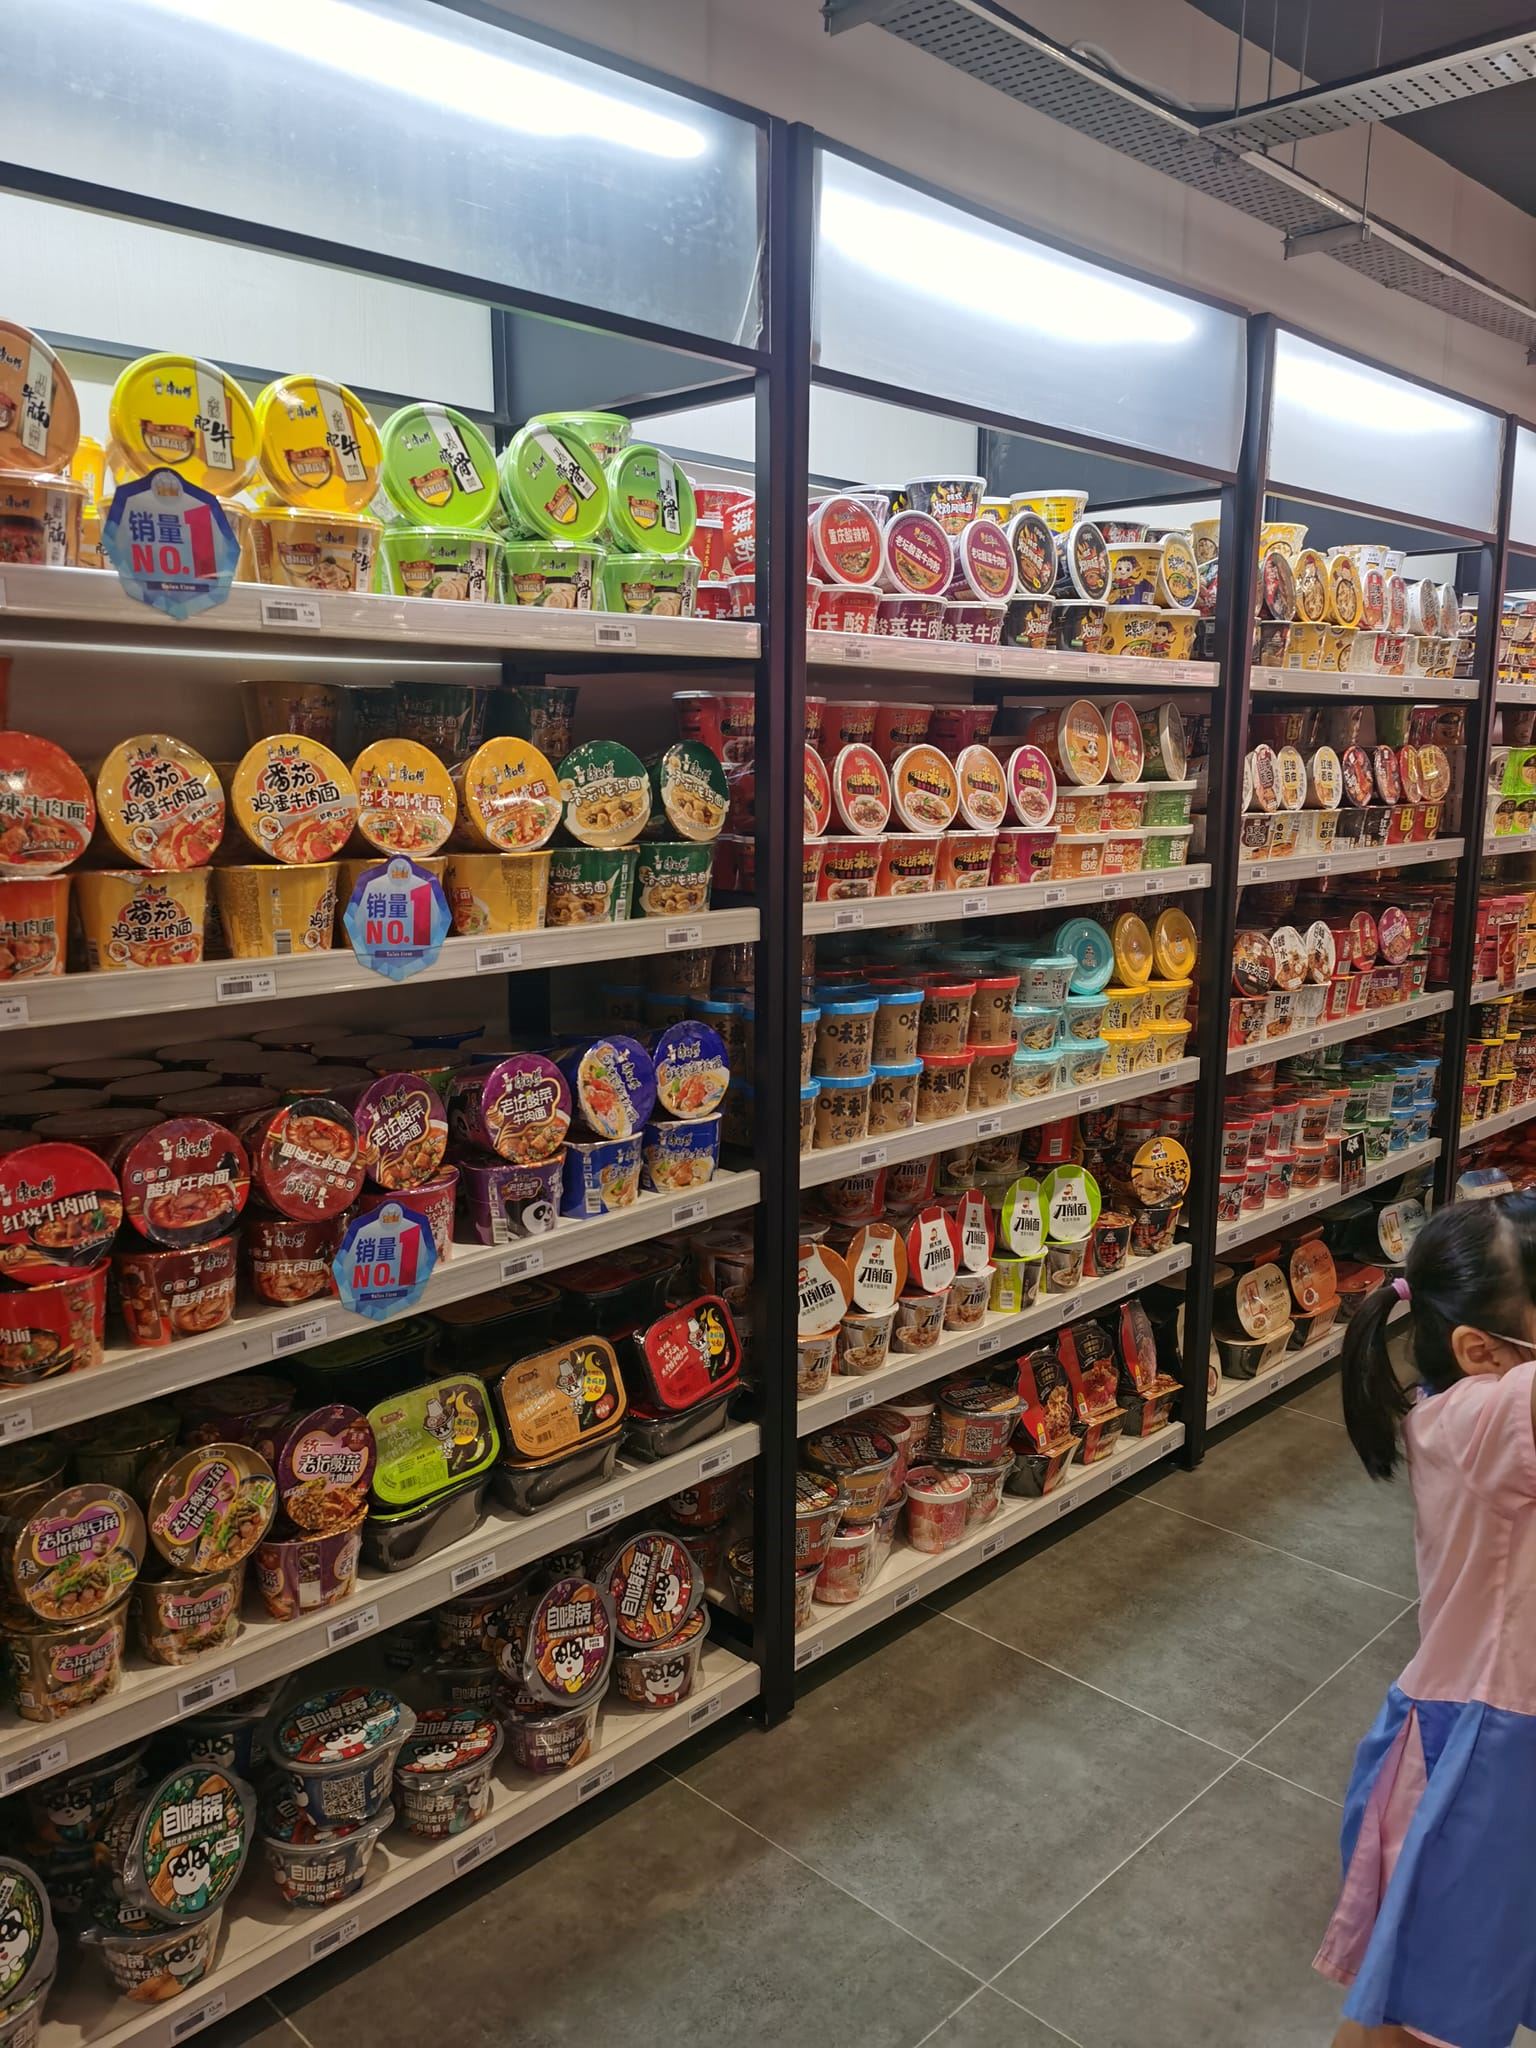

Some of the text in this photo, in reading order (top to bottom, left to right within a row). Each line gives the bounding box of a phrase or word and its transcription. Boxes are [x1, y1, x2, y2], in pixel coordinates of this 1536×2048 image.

[128, 510, 185, 546] 销量
[828, 526, 871, 546] 重庆酸辣粉
[129, 765, 180, 799] 番茄
[264, 763, 316, 792] 番茄
[570, 775, 642, 804] 香菇炖鸡面
[120, 780, 208, 825] 鸡蛋牛肉面
[251, 779, 342, 815] 鸡蛋牛肉面
[126, 900, 178, 925] 番茄
[365, 892, 410, 920] 销量
[112, 917, 192, 943] 鸡蛋牛肉面
[499, 1087, 554, 1118] 老坛酸菜
[512, 1105, 547, 1125] 牛肉面
[371, 1100, 426, 1147] 老坛酸菜
[388, 1123, 423, 1152] 牛肉面
[16, 1174, 57, 1202] 康师傅
[146, 1167, 231, 1200] 酸辣牛肉面
[0, 1191, 101, 1236] 红烧牛肉面
[1013, 1216, 1040, 1232] 刀削面
[1053, 1202, 1088, 1220] 刀削面
[355, 1237, 397, 1264] 销量
[965, 1229, 986, 1246] 刀削面
[923, 1244, 952, 1270] 刀削面
[857, 1266, 893, 1285] 刀削面
[298, 1453, 362, 1475] 老坛酸菜
[170, 1459, 229, 1537] 老坛酸豆角
[38, 1512, 121, 1549] 老坛酸豆角
[621, 1551, 651, 1617] 自嗨锅
[546, 1602, 592, 1631] 自嗨锅
[295, 1694, 368, 1732] 自嗨锅
[413, 1718, 478, 1737] 自嗨锅
[160, 1791, 224, 1837] 自嗨锅
[290, 1859, 347, 1882] 自嗨锅
